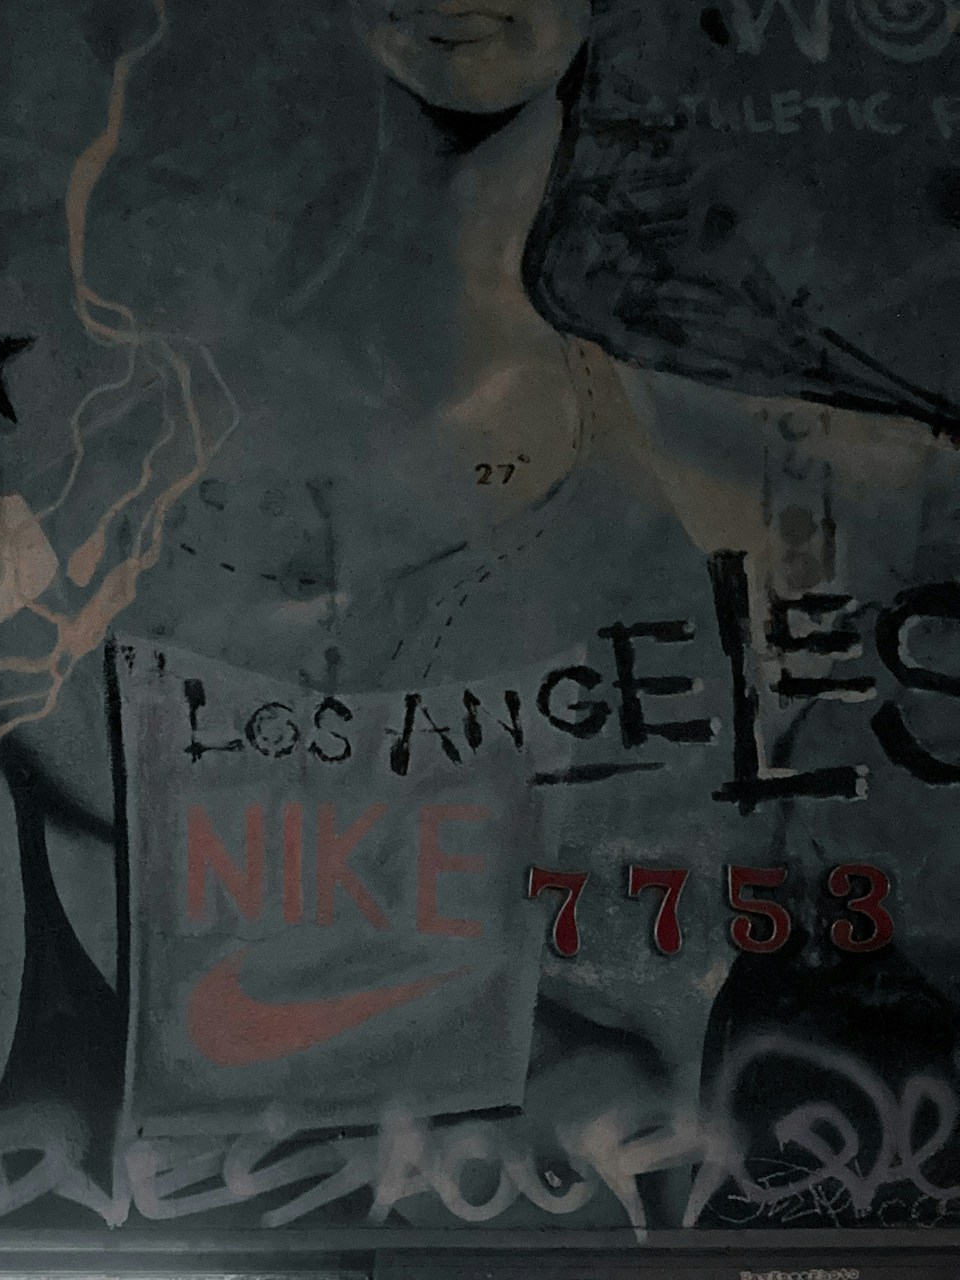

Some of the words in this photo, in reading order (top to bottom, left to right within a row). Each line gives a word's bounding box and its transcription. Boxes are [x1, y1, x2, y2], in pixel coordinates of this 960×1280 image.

[183, 677, 354, 763] LOS
[385, 549, 960, 813] ANGELES
[185, 802, 493, 938] NIKE
